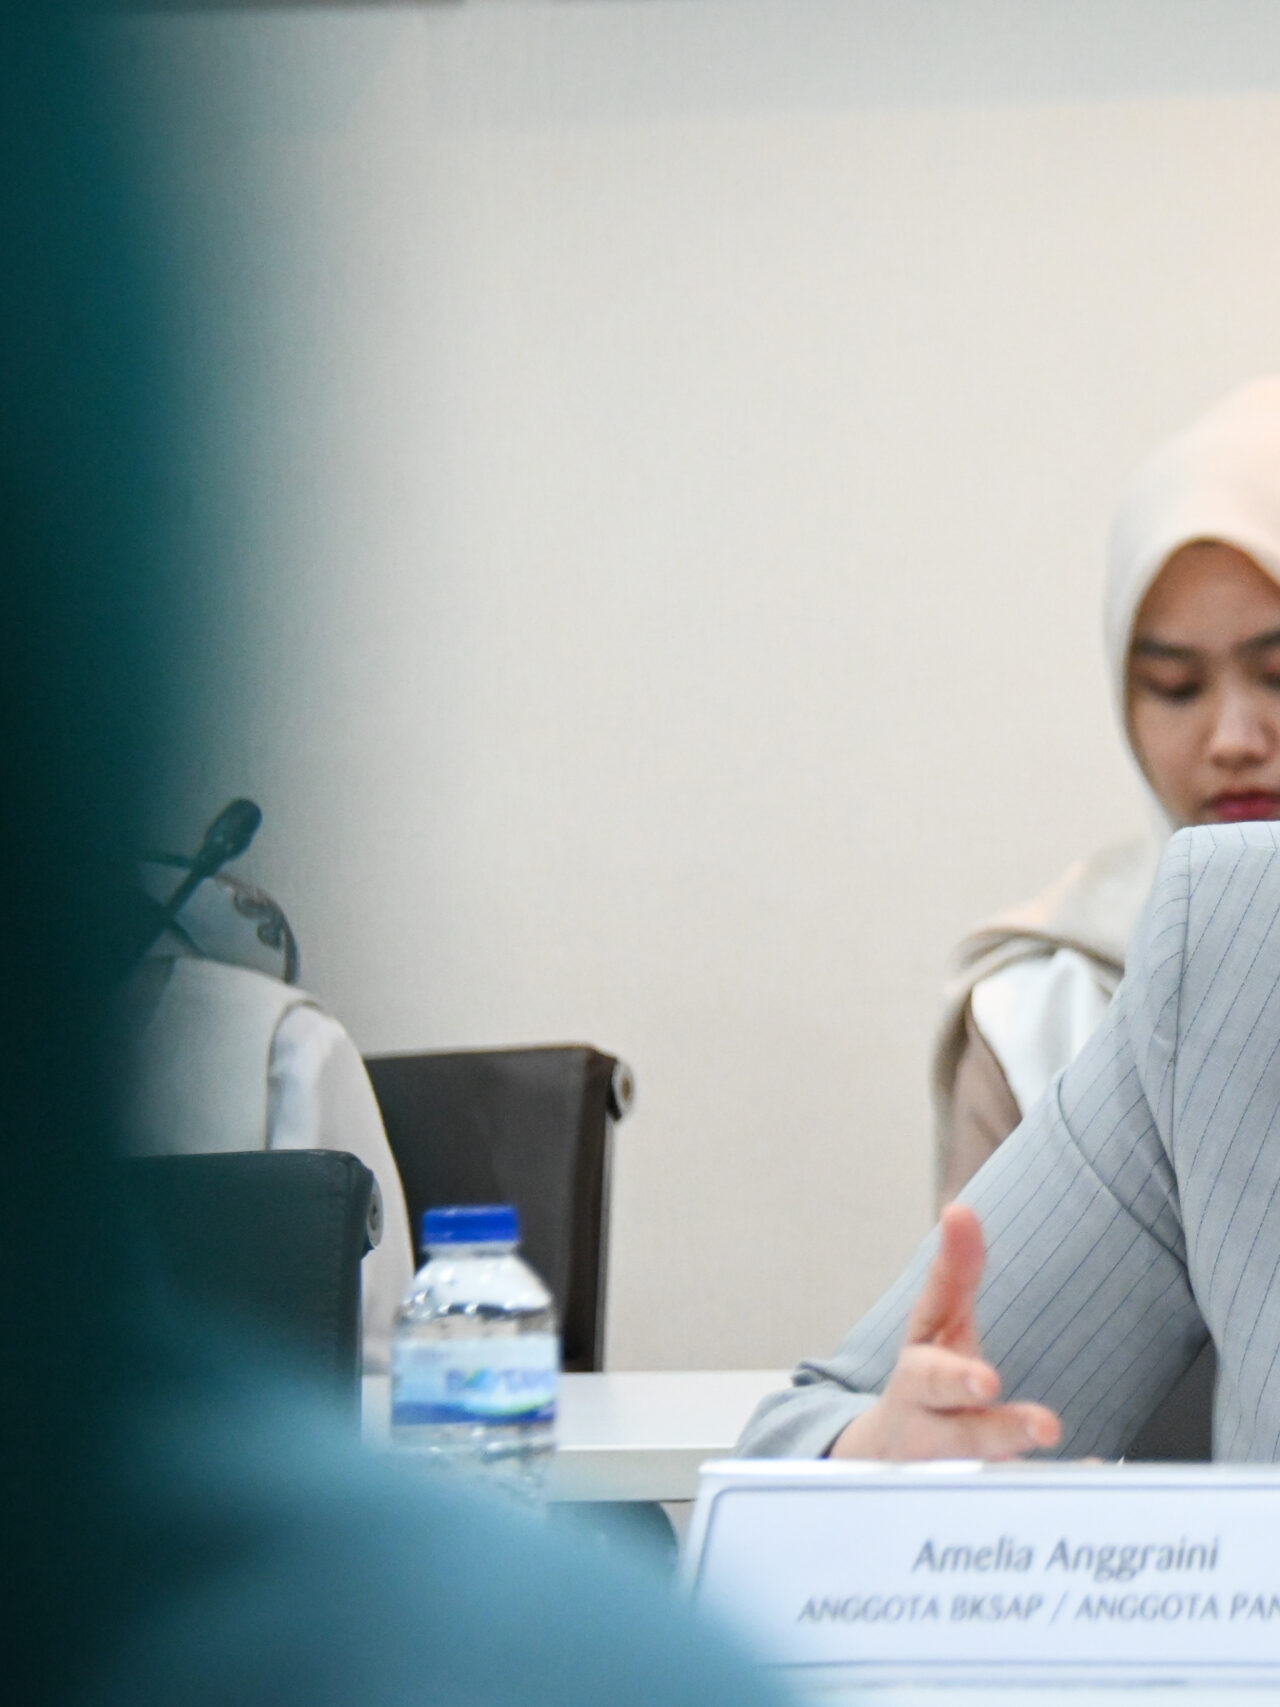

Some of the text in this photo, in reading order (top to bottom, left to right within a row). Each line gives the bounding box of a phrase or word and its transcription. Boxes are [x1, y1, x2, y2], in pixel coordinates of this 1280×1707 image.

[911, 1535, 1219, 1583] Amelia Anggraini
[797, 1594, 939, 1622] ANGGOTA
[949, 1593, 1044, 1621] BKSAP
[1074, 1593, 1219, 1621] ANGGOTA
